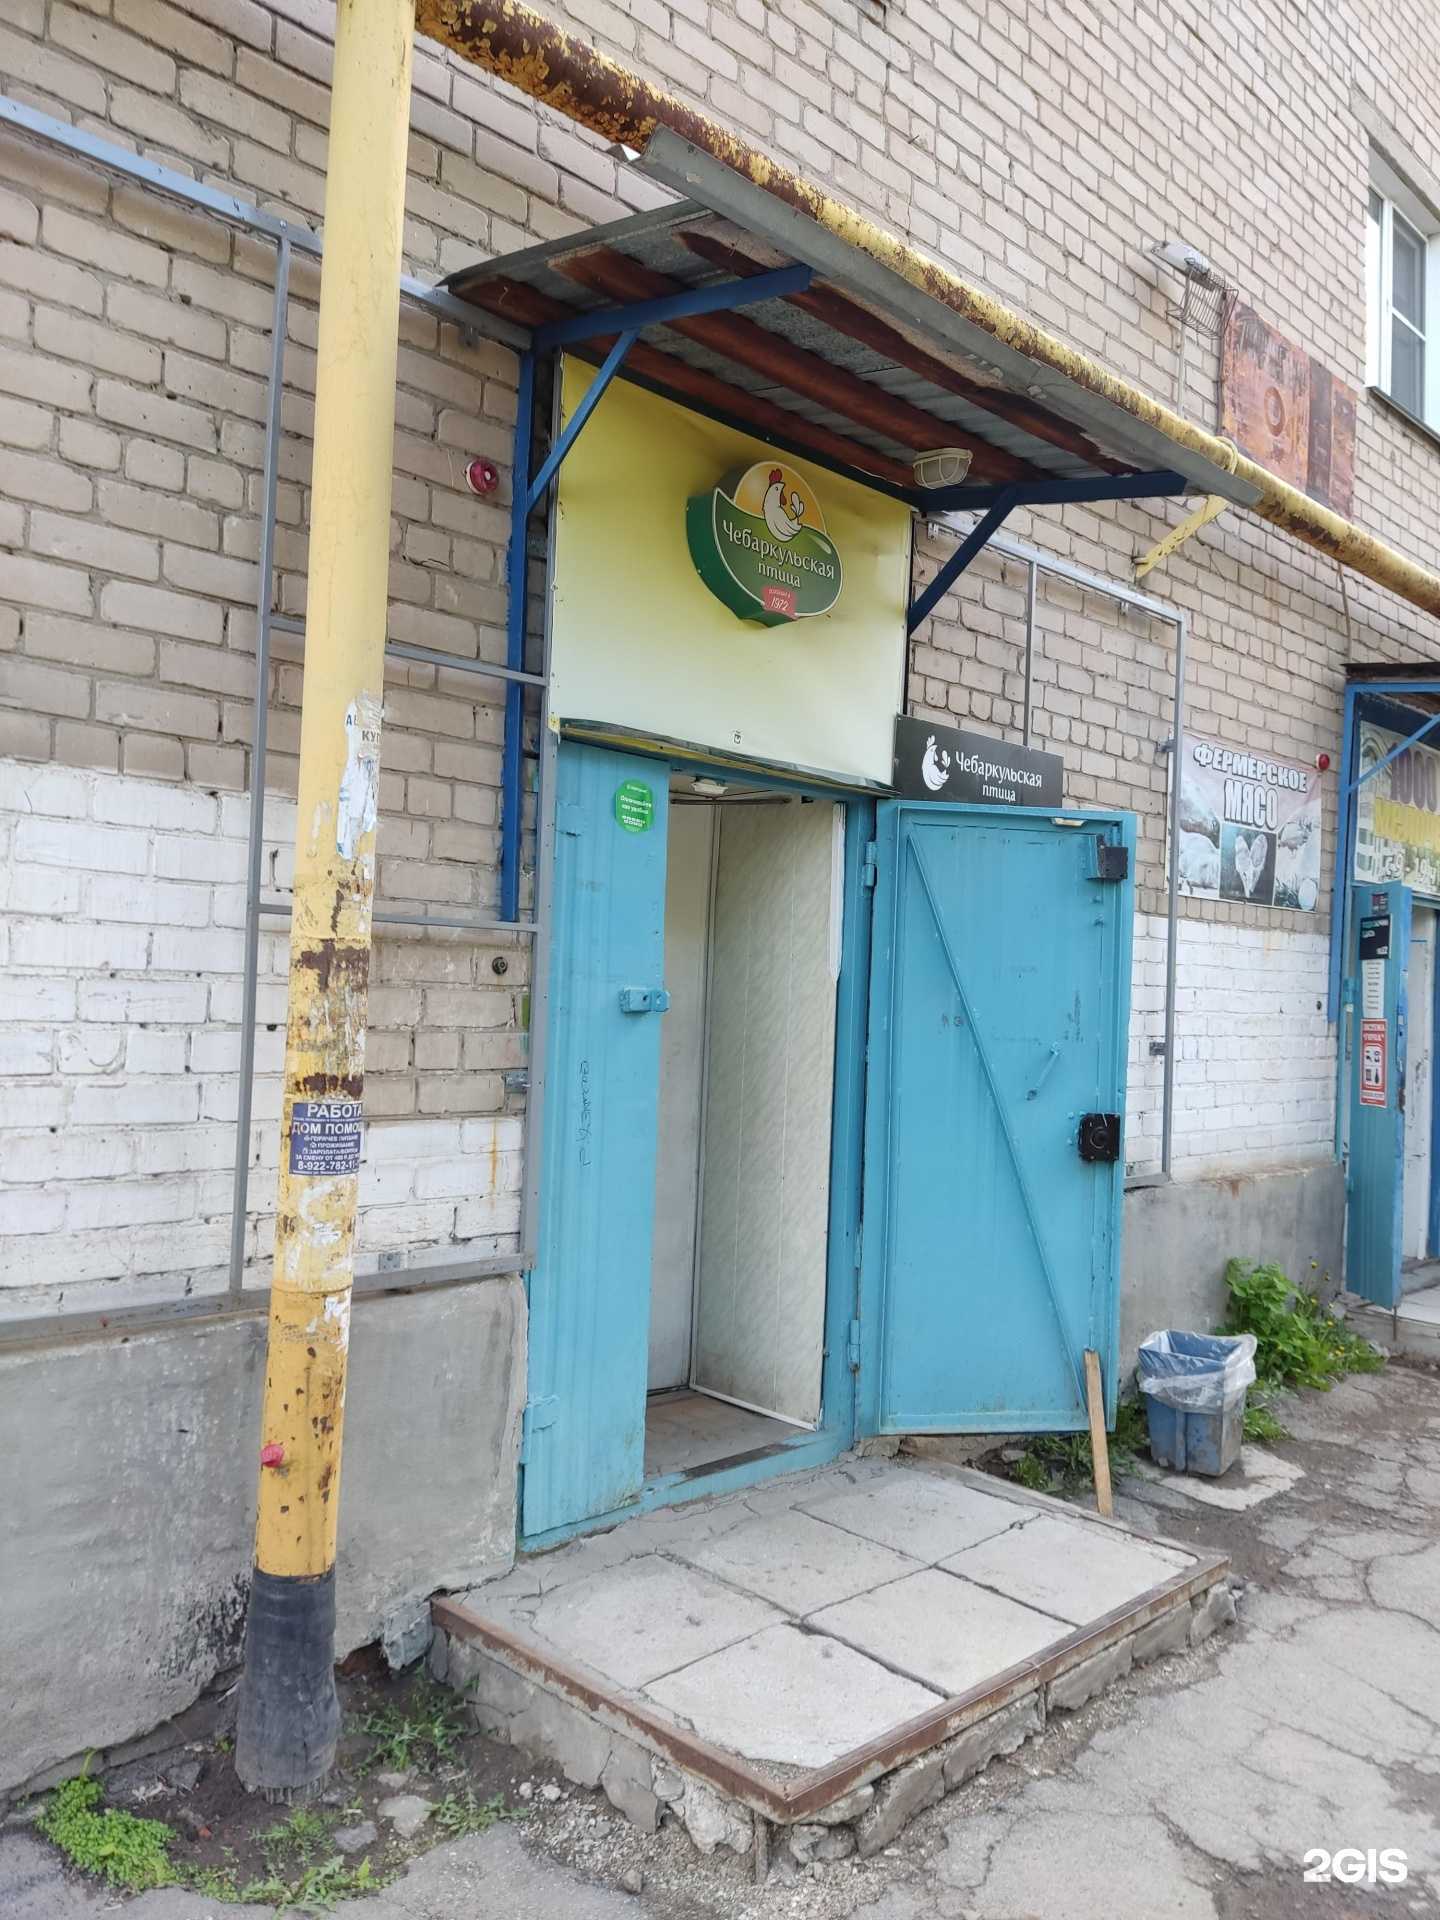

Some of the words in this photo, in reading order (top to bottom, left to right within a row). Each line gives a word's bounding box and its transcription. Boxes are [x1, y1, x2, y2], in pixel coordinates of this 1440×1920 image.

[722, 519, 835, 580] Чебаркульская
[757, 562, 801, 588] птица
[770, 597, 790, 611] 1972
[955, 750, 1043, 789] Чебаркульская
[1193, 743, 1308, 794] ФЕРМЕРСКОЕ
[982, 784, 1017, 803] птица
[1223, 777, 1280, 831] МЯСО
